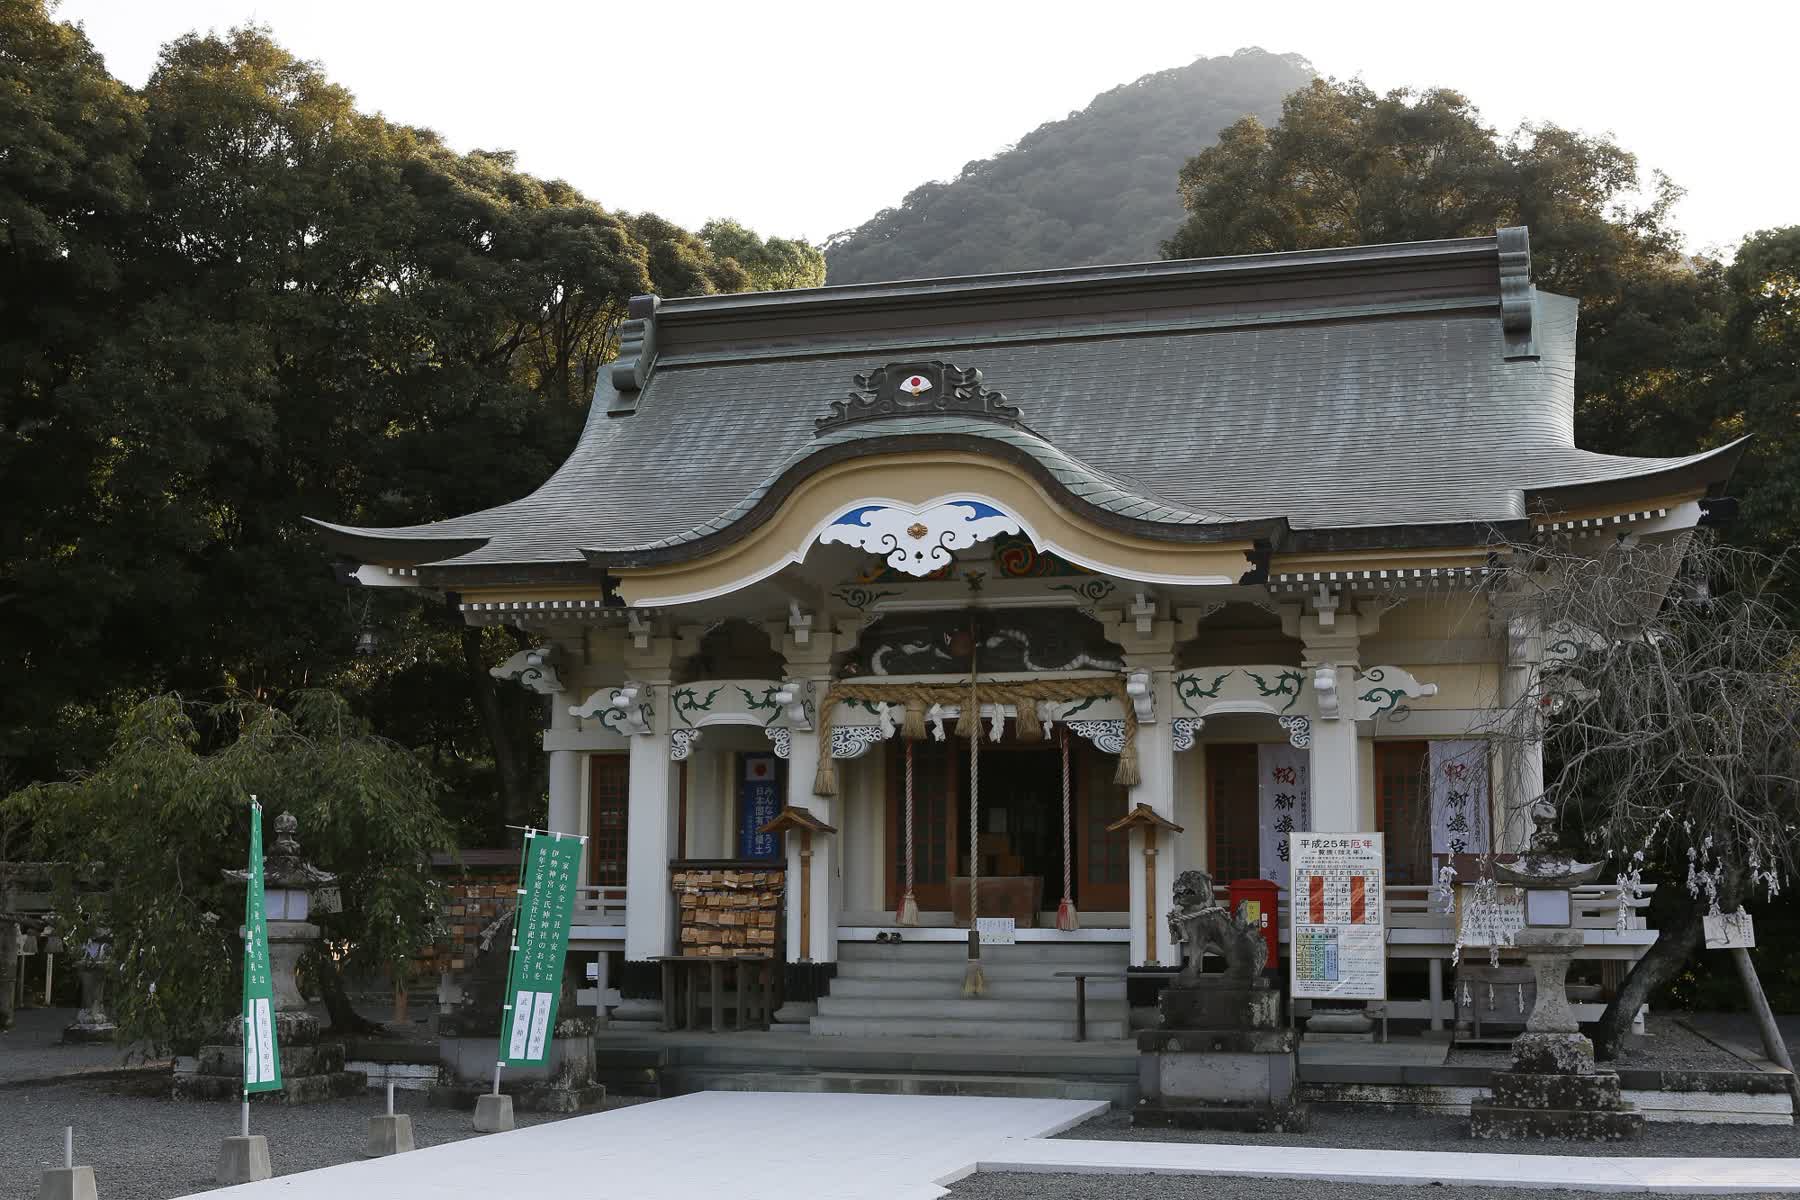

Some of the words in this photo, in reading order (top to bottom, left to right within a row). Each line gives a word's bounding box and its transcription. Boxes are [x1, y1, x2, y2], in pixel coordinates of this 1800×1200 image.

[1300, 839, 1373, 849] 平成25年厄年
